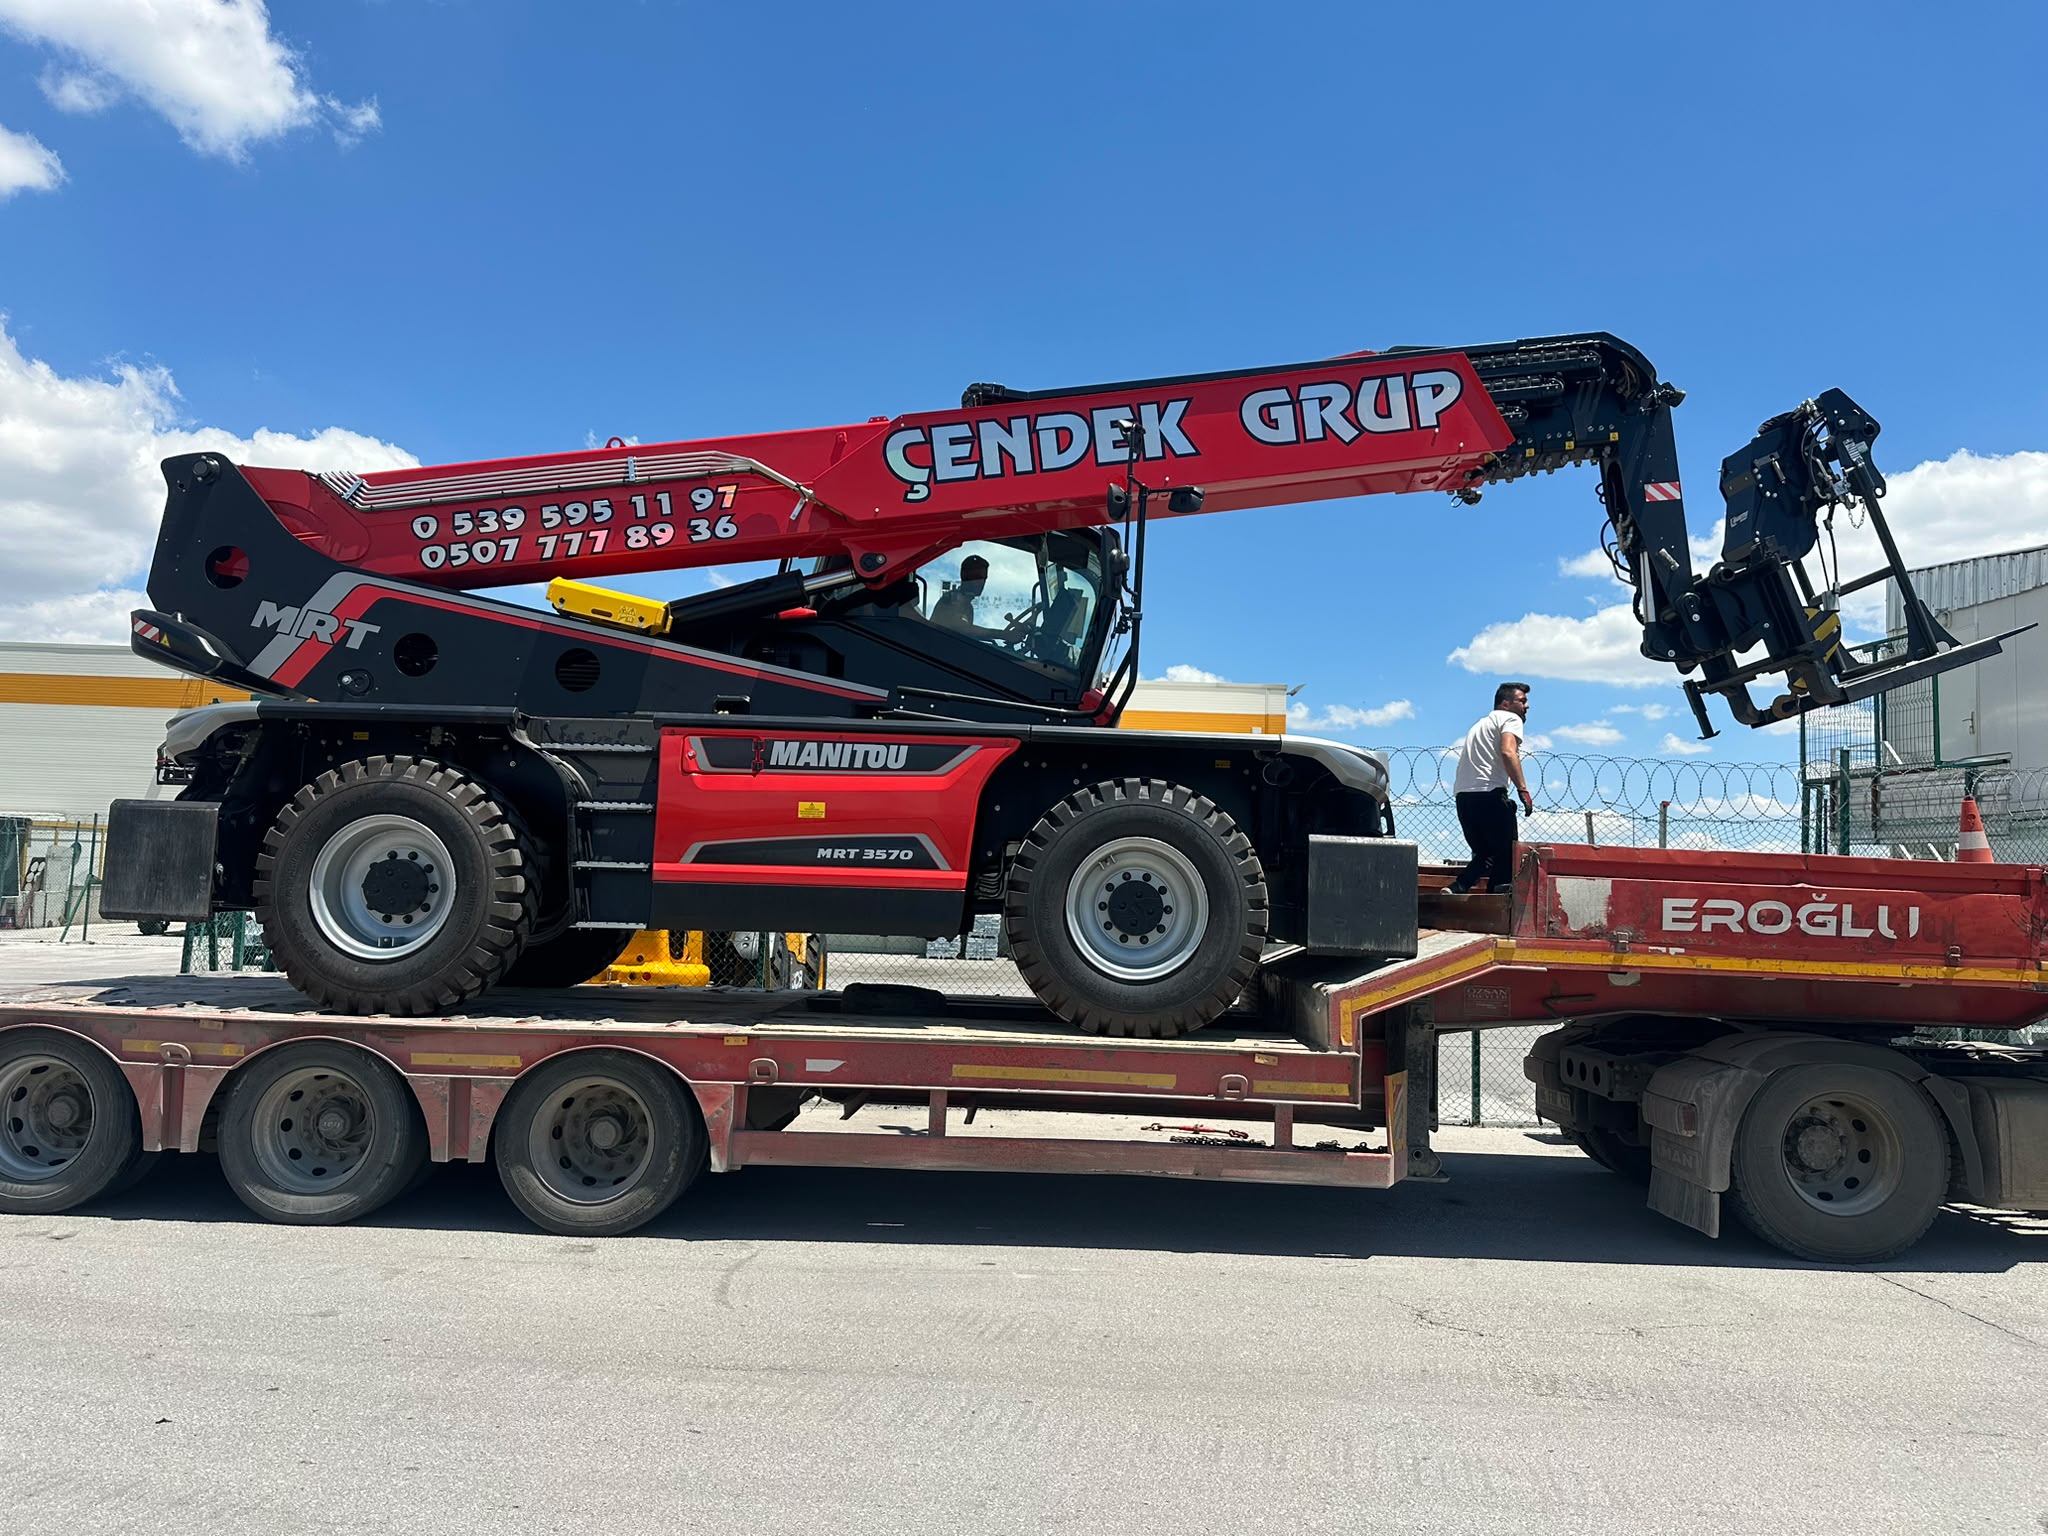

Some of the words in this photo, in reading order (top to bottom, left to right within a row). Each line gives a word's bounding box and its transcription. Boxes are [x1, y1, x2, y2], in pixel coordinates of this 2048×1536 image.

[883, 399, 1198, 500] ÇENDEK
[1241, 370, 1463, 443] GRUP
[411, 515, 438, 540] 0
[452, 507, 526, 536] 539
[540, 499, 613, 529] 595
[630, 493, 673, 518] 11
[689, 484, 738, 511] 97
[420, 537, 520, 569] 0507
[537, 529, 609, 560] 777
[625, 522, 675, 549] 89
[688, 516, 738, 543] 36
[250, 600, 381, 650] MRT
[769, 741, 909, 769] MANITOU
[816, 848, 860, 859] MRT
[862, 849, 914, 860] 3570
